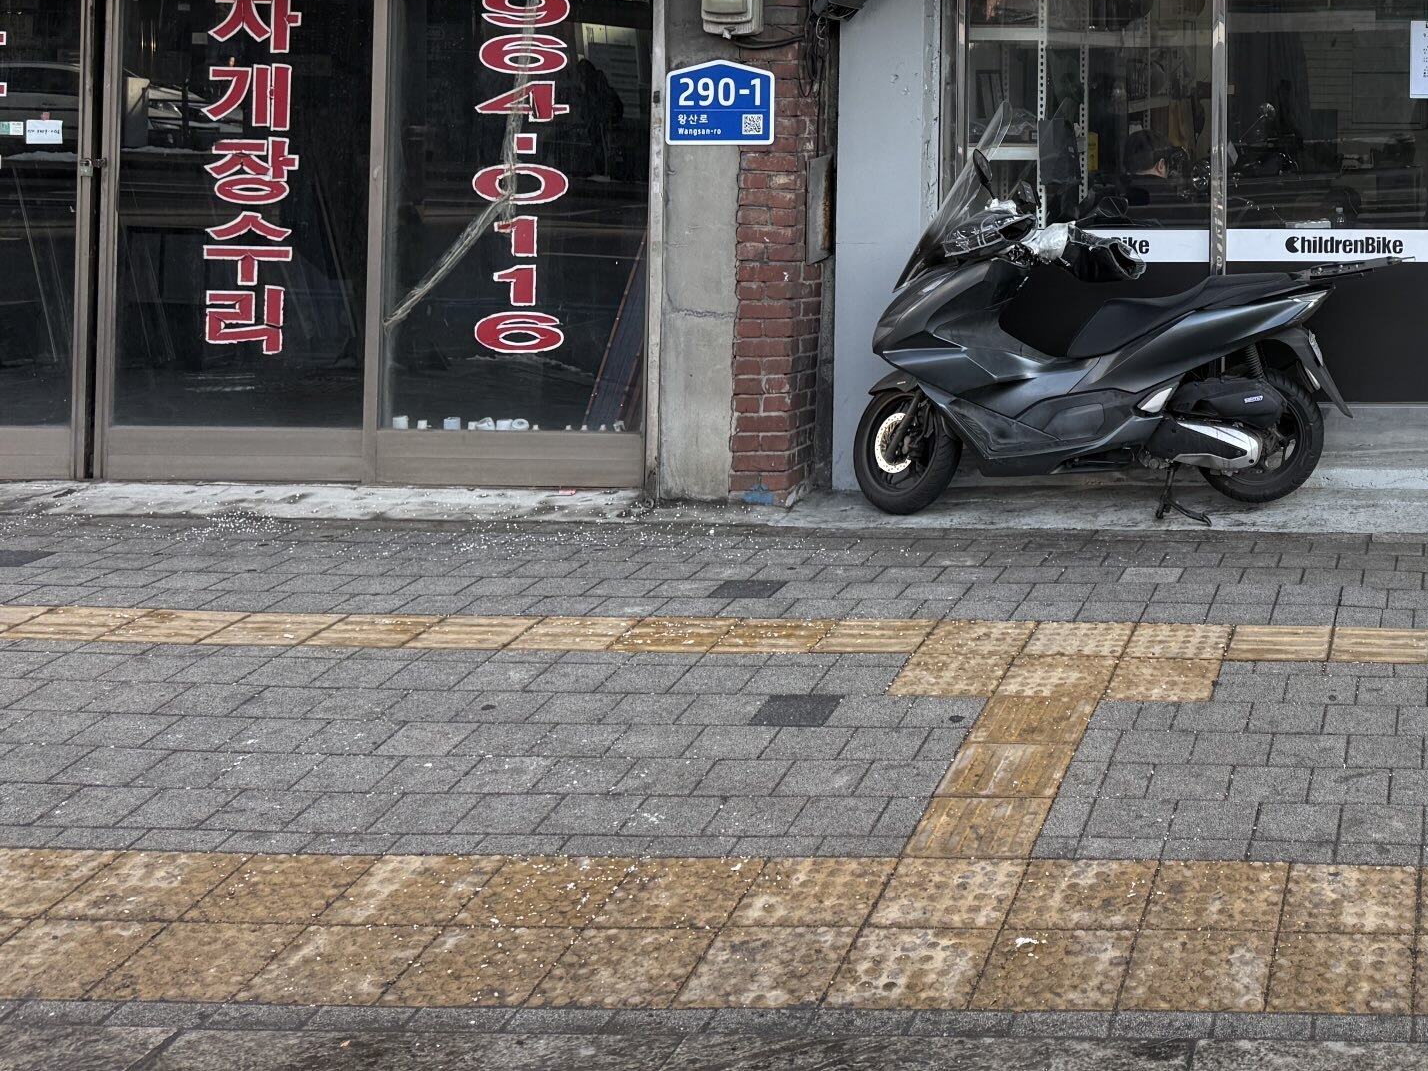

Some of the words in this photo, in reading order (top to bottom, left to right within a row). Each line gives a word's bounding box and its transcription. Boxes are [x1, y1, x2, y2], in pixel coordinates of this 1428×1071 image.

[678, 77, 761, 106] 290-1
[677, 113, 708, 125] 왕산로
[677, 127, 722, 136] Wangsan-ro
[1284, 236, 1404, 254] ChildrenBike
